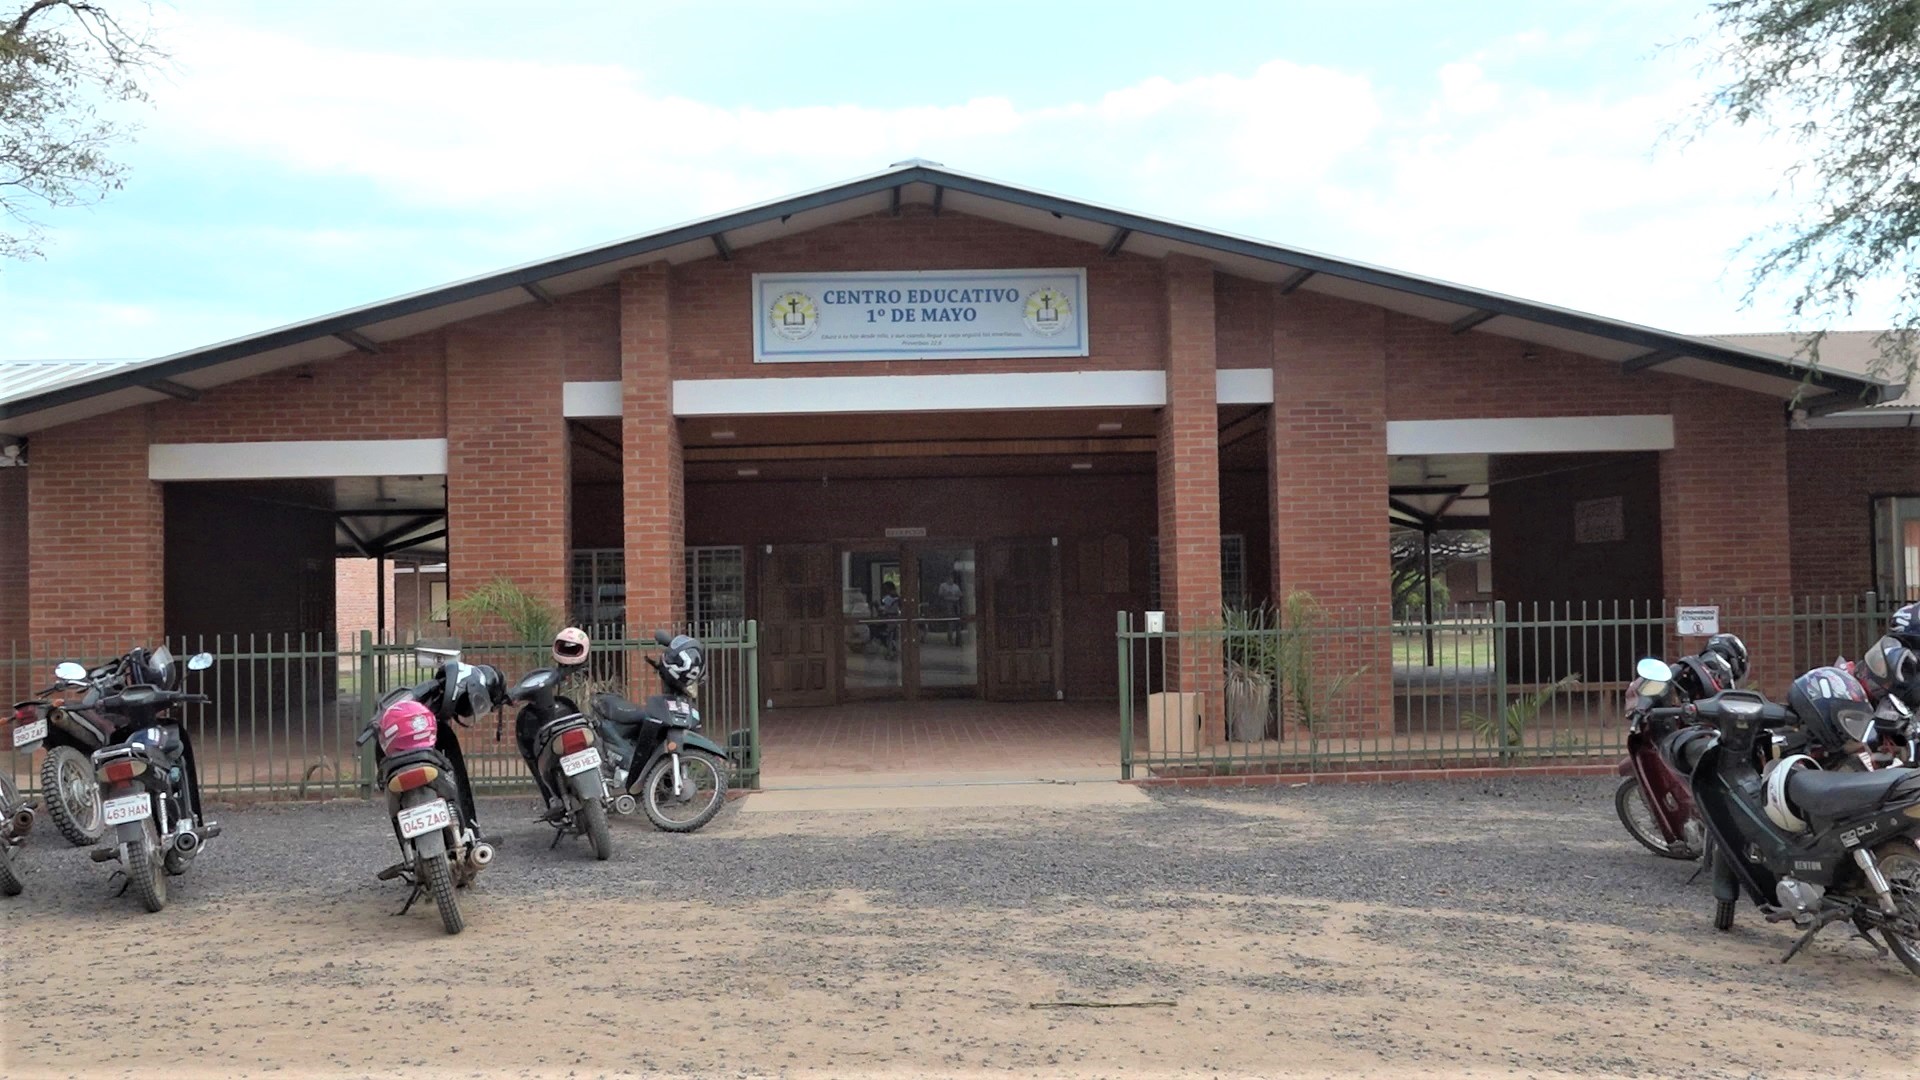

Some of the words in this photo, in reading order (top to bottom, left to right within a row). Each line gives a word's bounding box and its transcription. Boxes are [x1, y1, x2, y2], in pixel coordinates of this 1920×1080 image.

[823, 289, 901, 304] CENTRO
[907, 288, 1020, 303] EDUCATIVO
[891, 308, 915, 322] DE
[921, 307, 977, 322] MAYO
[565, 760, 581, 773] 238
[581, 755, 599, 767] HEE
[107, 807, 126, 820] 463
[128, 803, 149, 816] HAN
[403, 818, 425, 833] 045
[425, 810, 447, 826] ZAG
